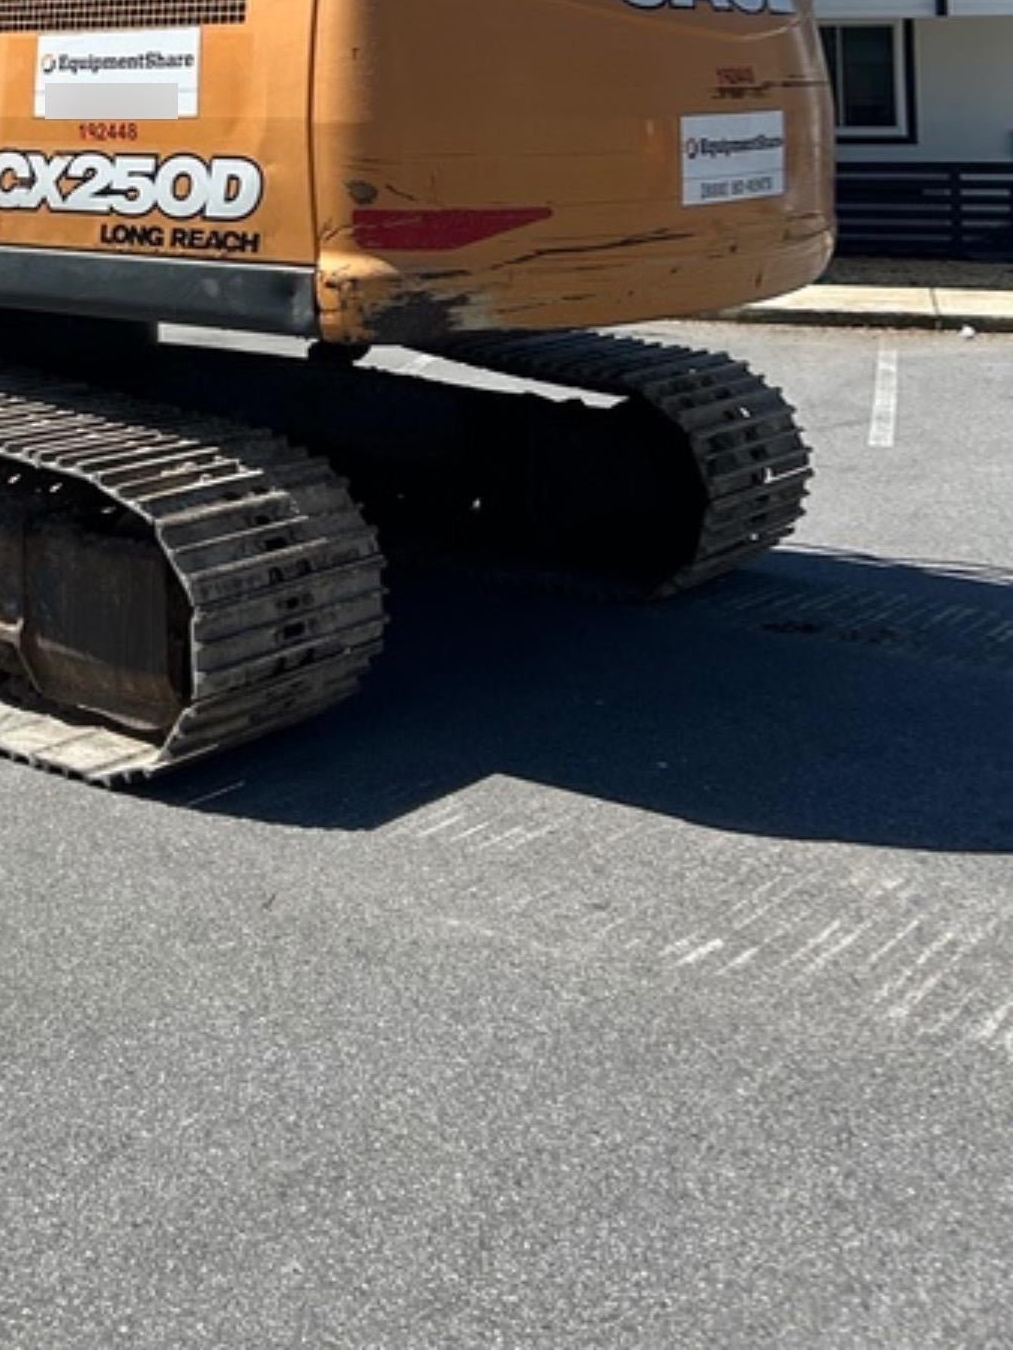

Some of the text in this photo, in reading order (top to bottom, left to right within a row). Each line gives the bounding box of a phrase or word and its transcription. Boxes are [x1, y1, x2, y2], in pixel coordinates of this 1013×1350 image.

[58, 51, 195, 75] EquipmentShare
[79, 122, 138, 141] 192448
[100, 224, 260, 252] LONG REACH
